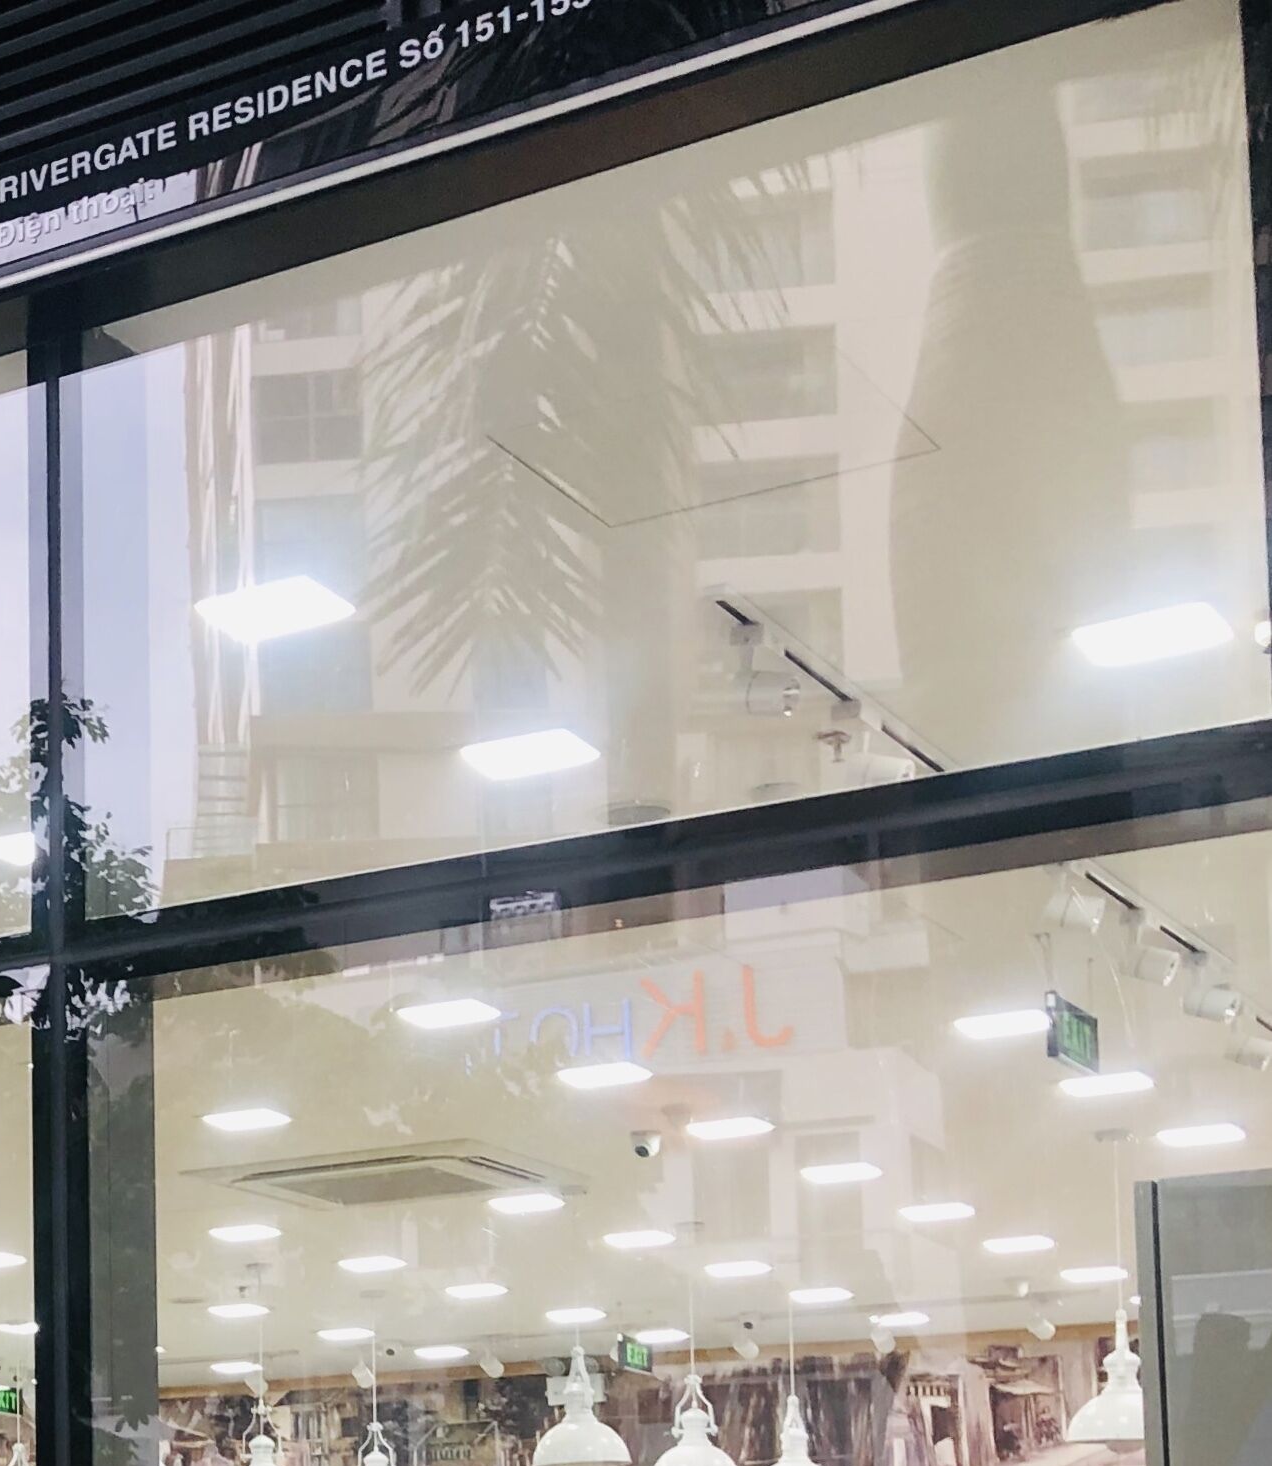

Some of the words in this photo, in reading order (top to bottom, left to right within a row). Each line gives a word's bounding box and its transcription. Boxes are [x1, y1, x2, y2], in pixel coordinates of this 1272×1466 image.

[188, 48, 388, 142] RESIDENCE
[398, 22, 448, 69] Số
[69, 175, 158, 226] thoại:
